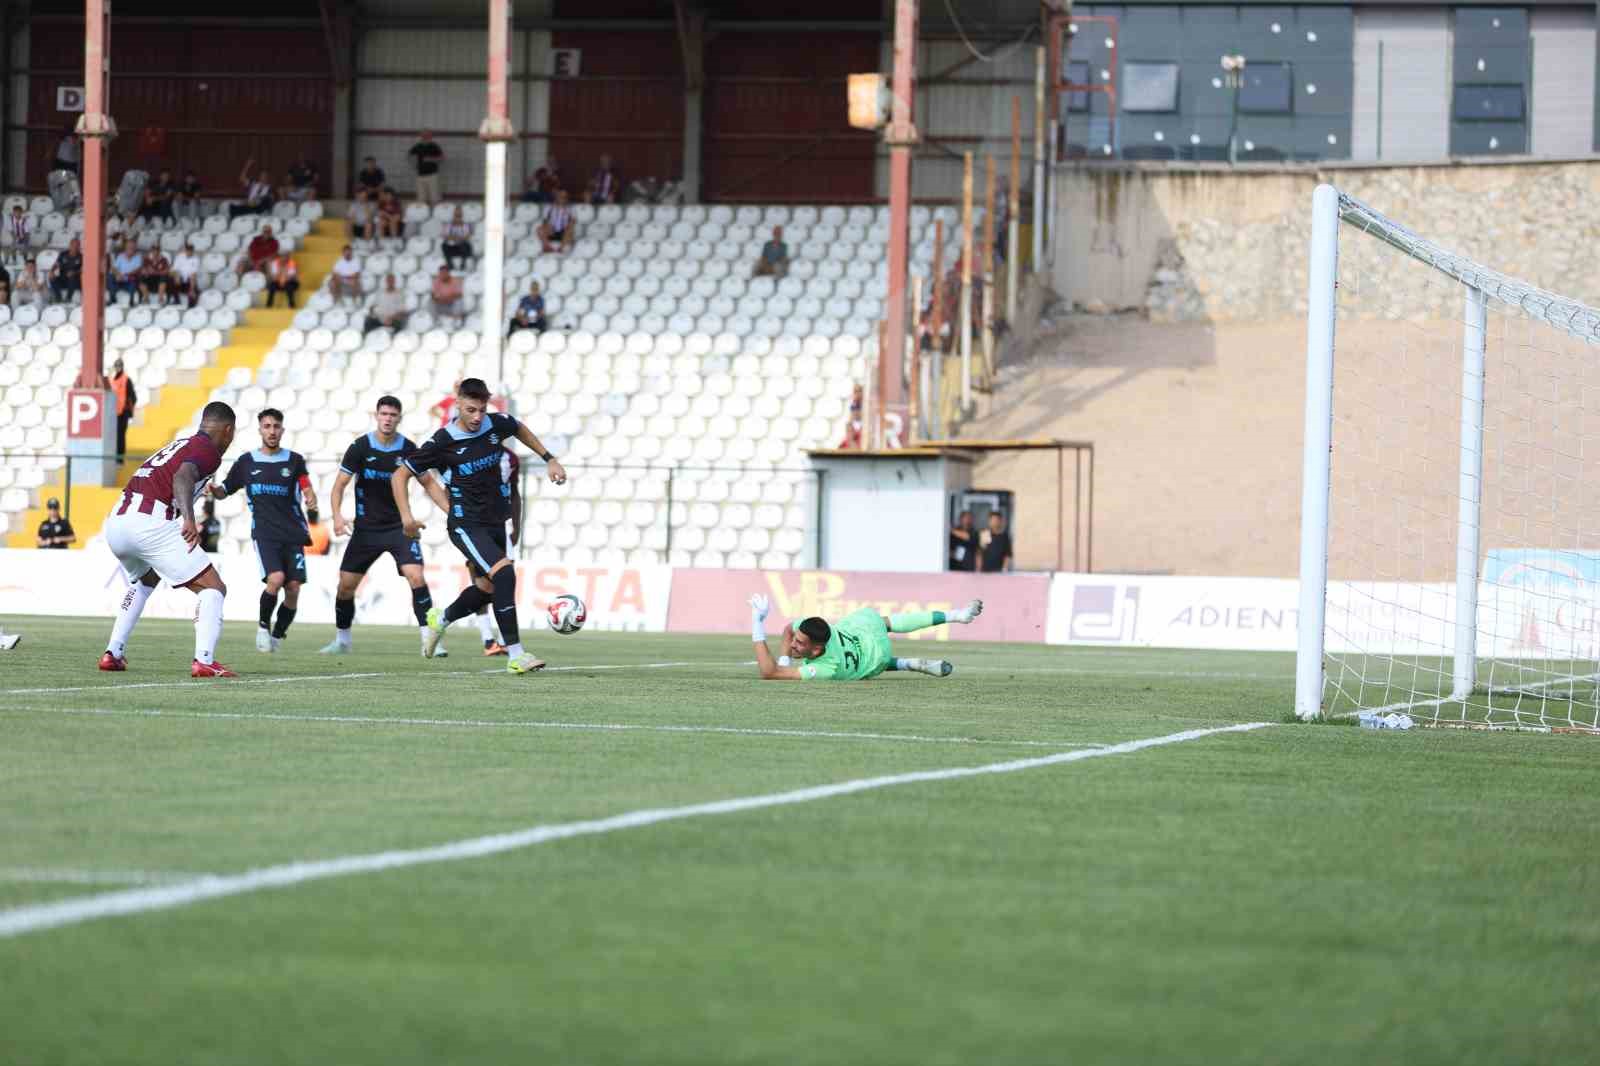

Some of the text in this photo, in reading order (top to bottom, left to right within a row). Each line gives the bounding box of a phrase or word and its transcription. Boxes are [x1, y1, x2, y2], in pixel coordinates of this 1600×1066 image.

[554, 51, 570, 77] E
[63, 89, 80, 107] D
[71, 395, 98, 434] P
[874, 412, 904, 449] R
